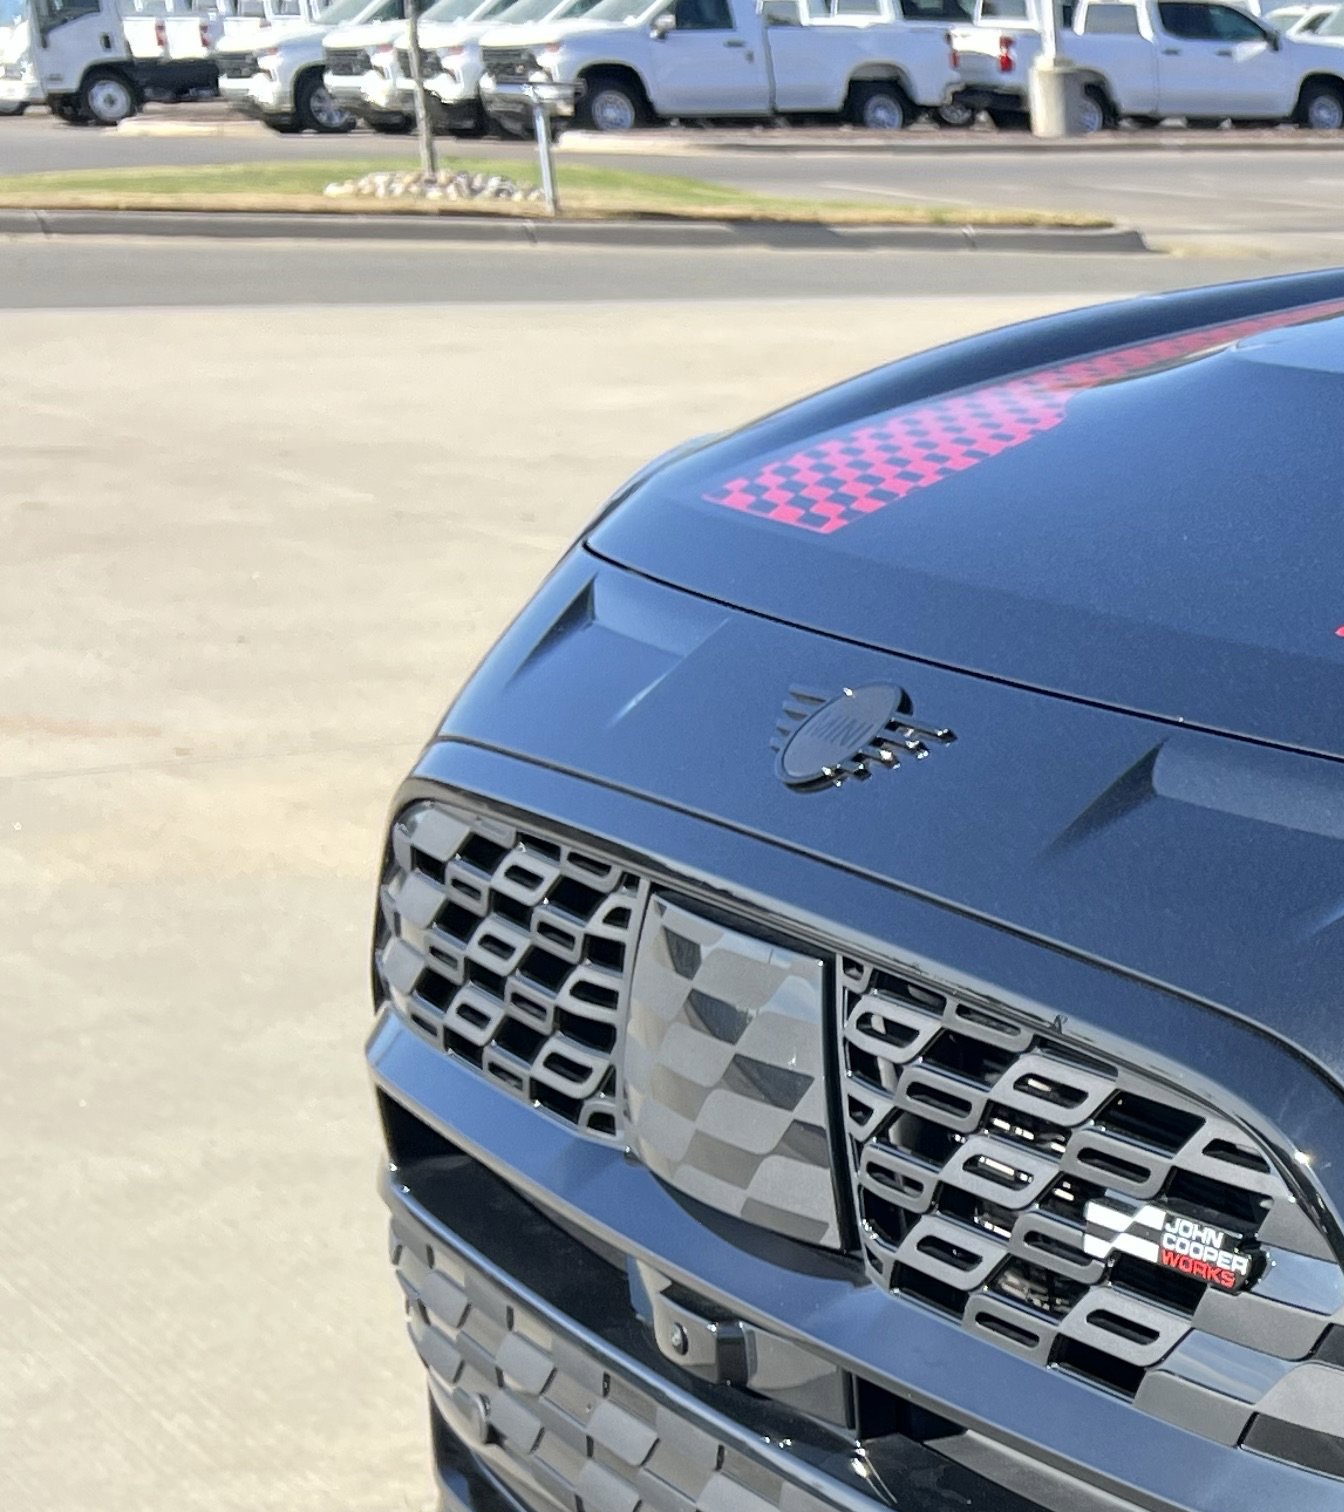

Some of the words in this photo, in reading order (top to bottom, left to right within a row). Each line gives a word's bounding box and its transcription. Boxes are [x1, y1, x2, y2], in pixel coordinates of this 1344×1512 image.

[1164, 1217, 1225, 1248] JOHN
[1162, 1250, 1235, 1288] WORKS
[1163, 1234, 1249, 1275] COOPER
